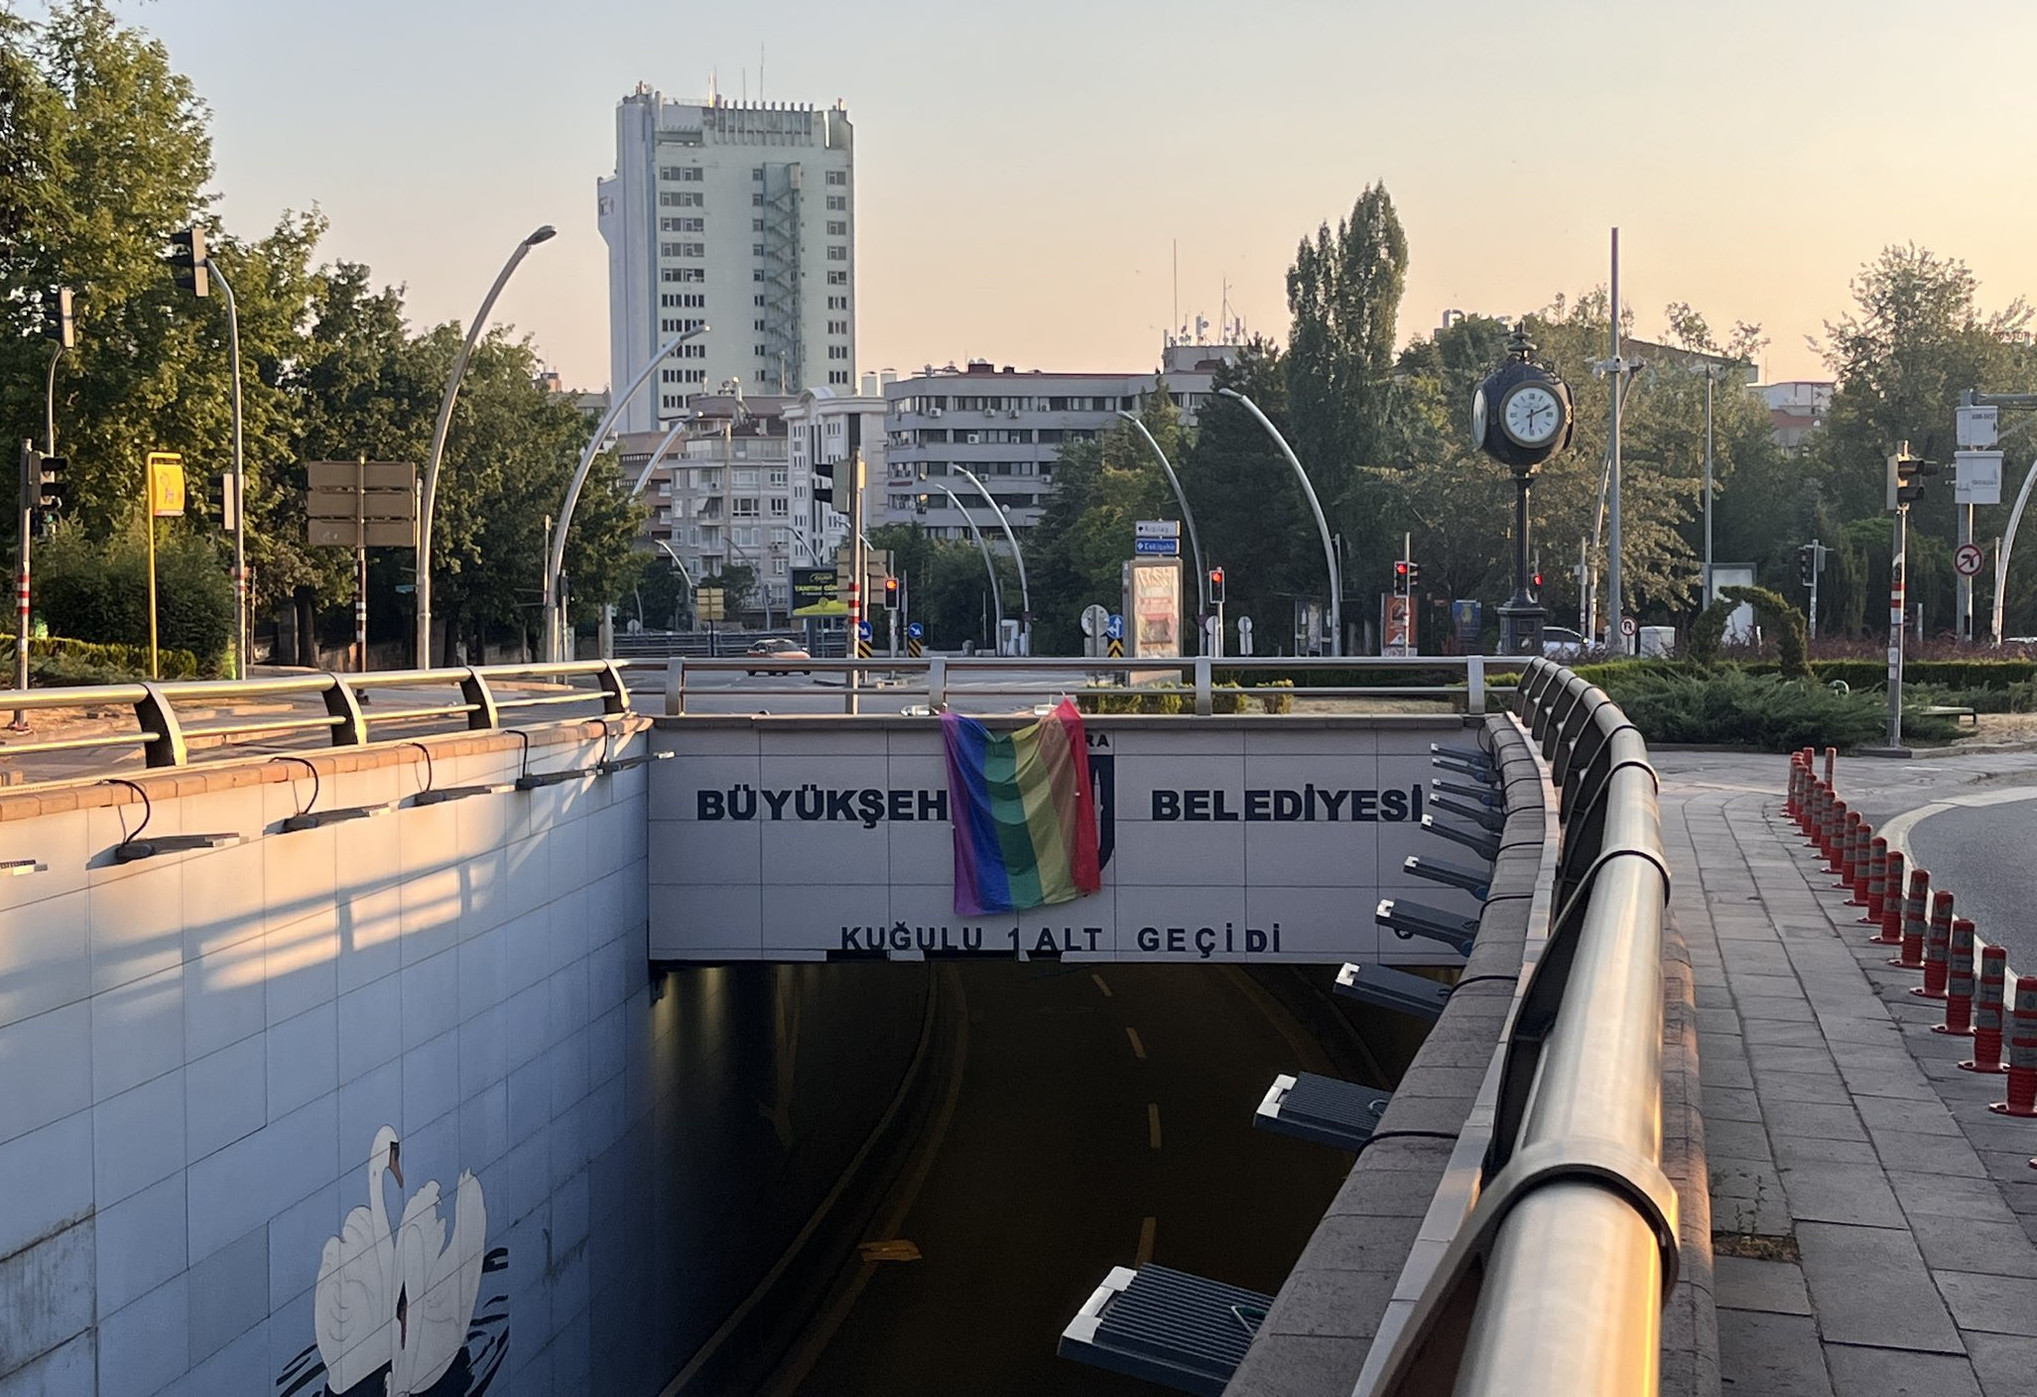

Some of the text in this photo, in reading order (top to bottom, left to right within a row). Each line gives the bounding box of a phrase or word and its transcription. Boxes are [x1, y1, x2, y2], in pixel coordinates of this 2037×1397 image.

[697, 783, 1423, 829] BÜYÜKŞEH BELEDİYESİ
[841, 921, 1280, 958] KUĞULU 1 ALT GEÇİDİ
